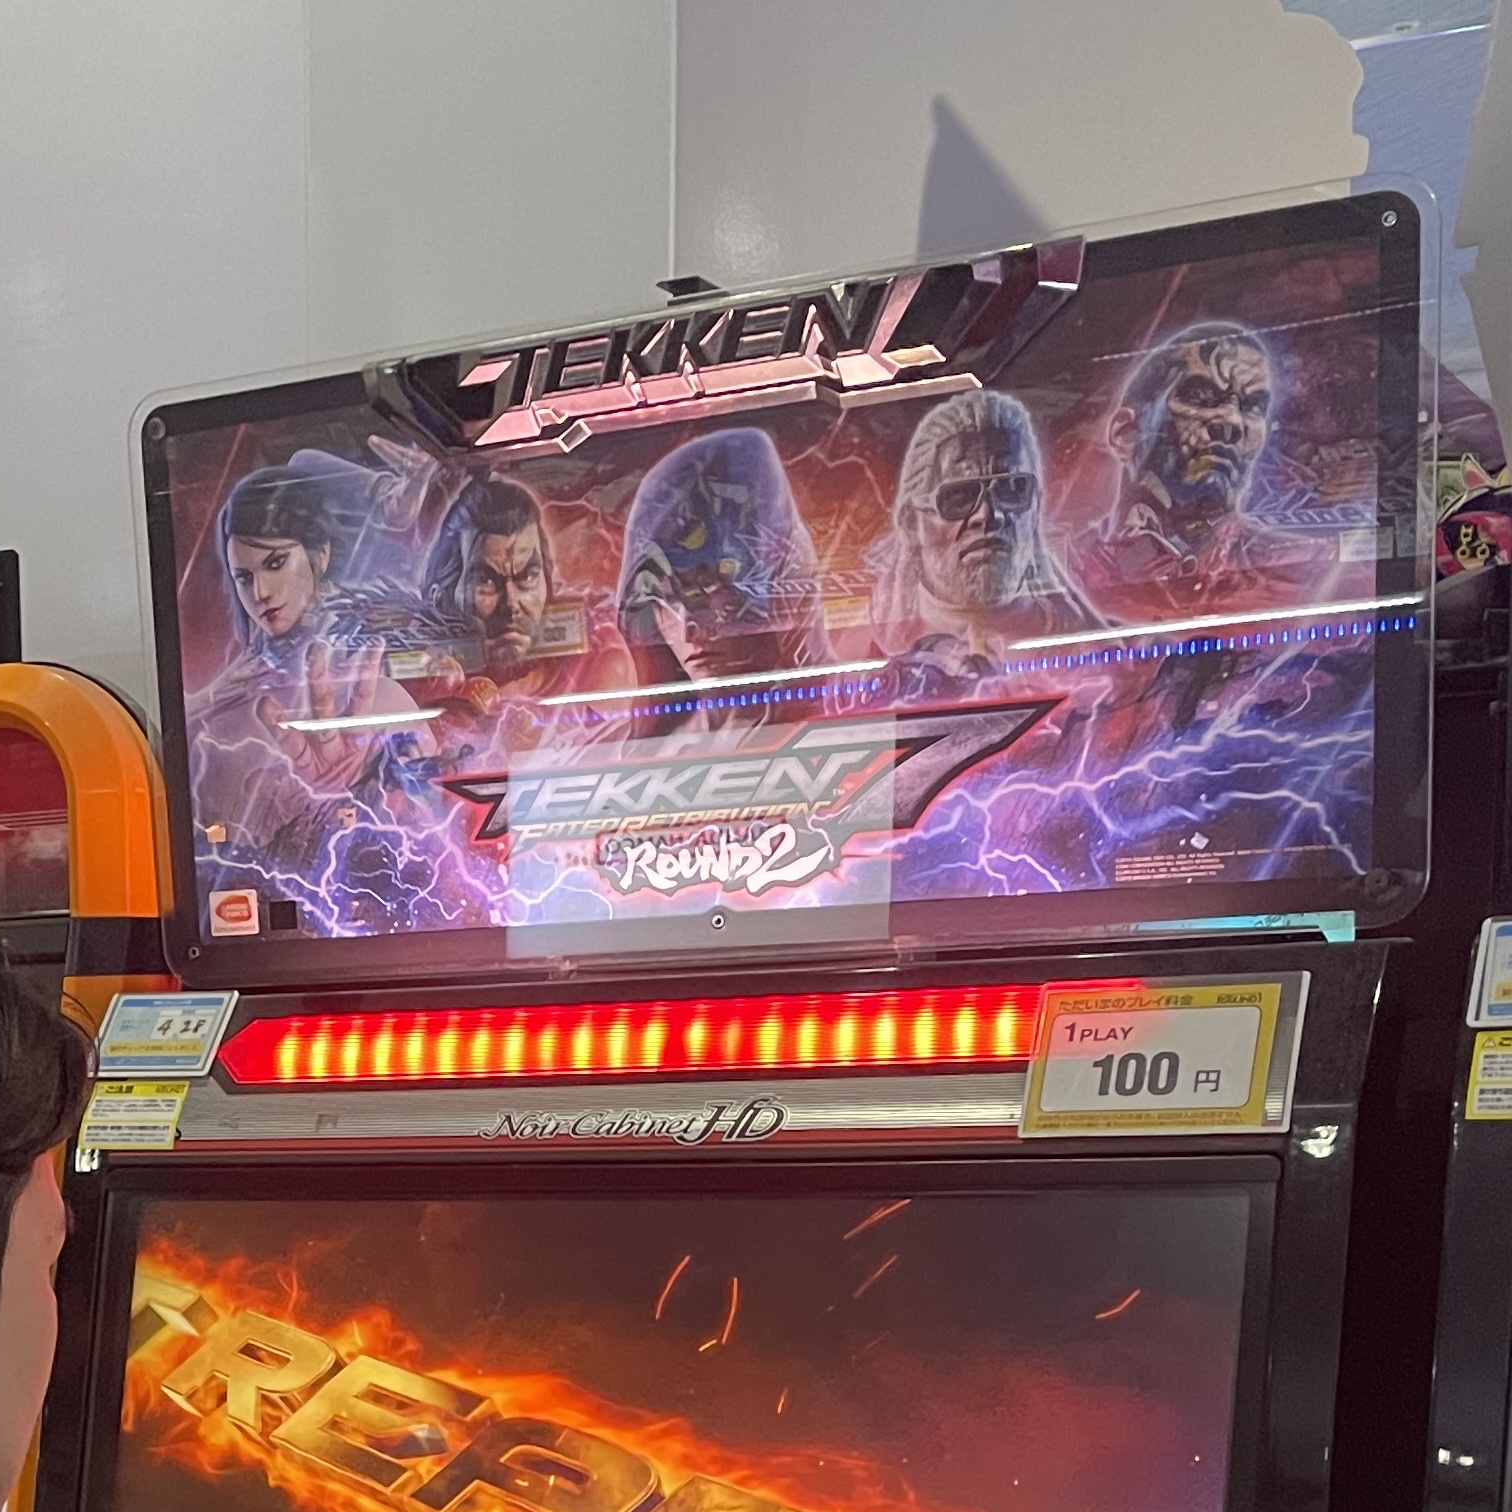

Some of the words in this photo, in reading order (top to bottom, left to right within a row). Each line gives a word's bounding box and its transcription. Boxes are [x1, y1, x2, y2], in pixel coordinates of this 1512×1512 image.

[470, 274, 923, 432] TEKKEN
[454, 748, 873, 836] TEKKEN
[744, 822, 832, 893] 2
[1058, 994, 1194, 1013] ただいまのプレイ料金
[1092, 1051, 1181, 1097] 100
[1193, 1069, 1222, 1094] 円
[481, 1102, 562, 1139] Noir
[569, 1099, 704, 1139] Cabinet
[676, 1096, 789, 1145] HD
